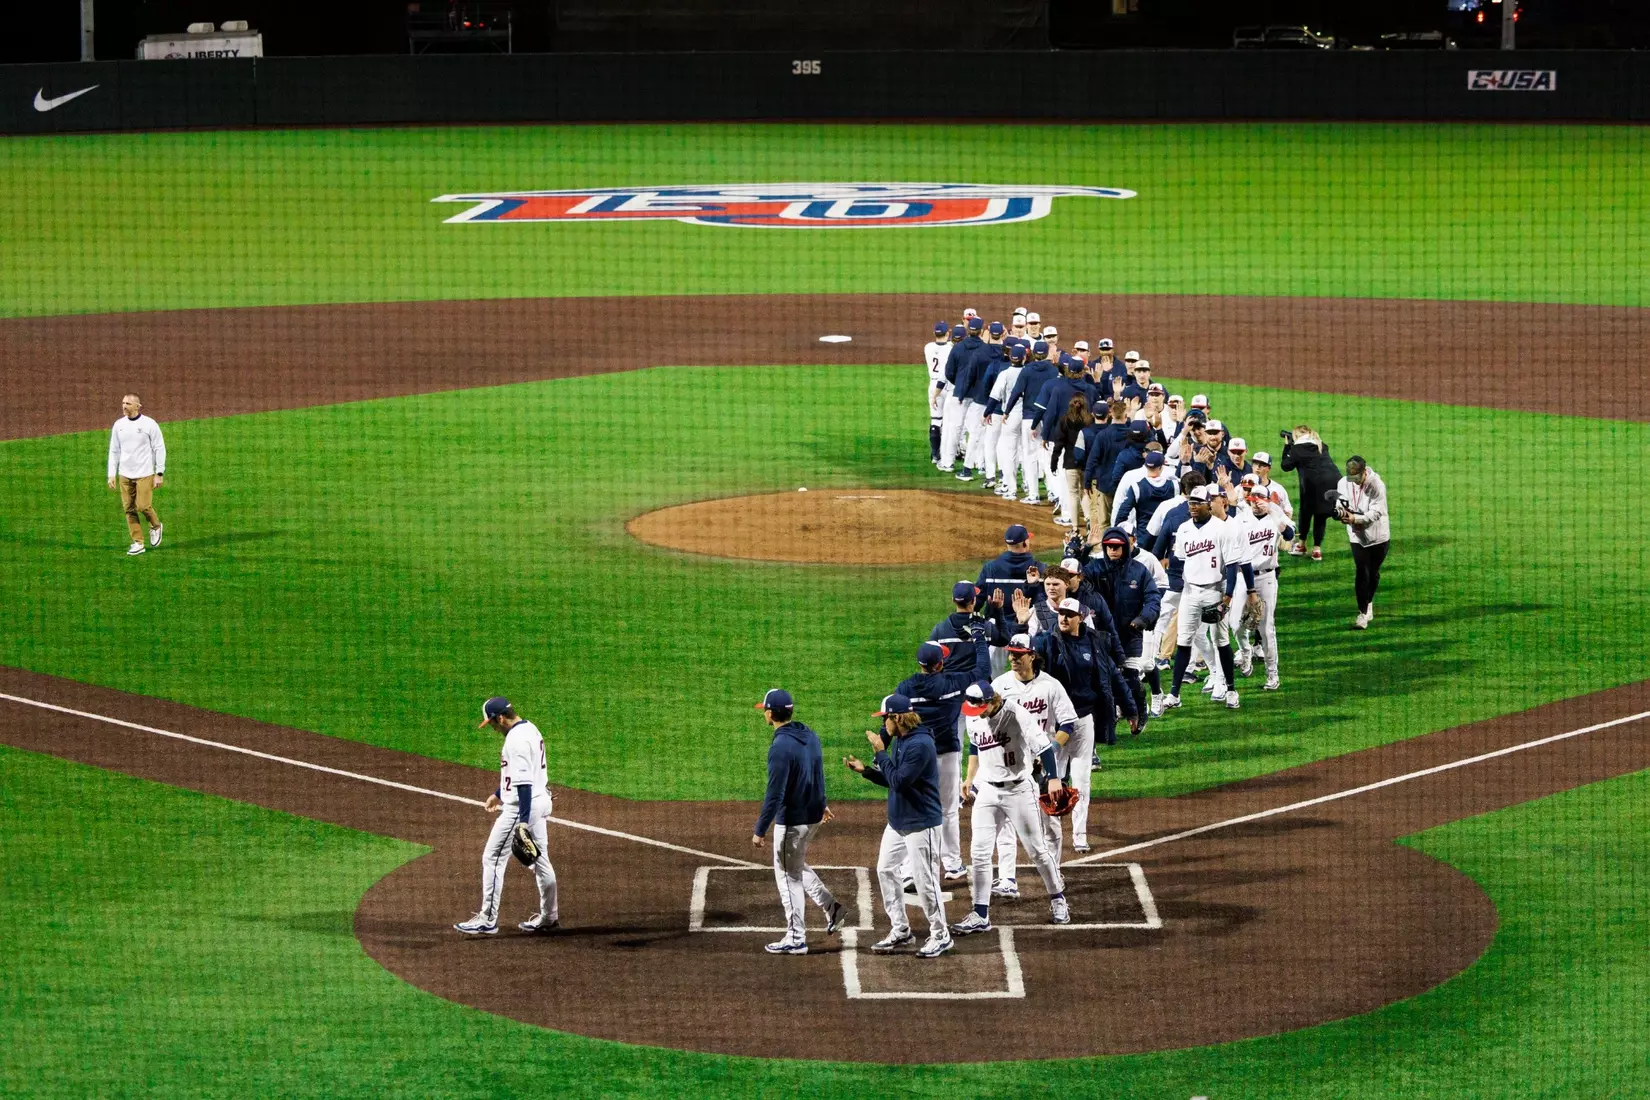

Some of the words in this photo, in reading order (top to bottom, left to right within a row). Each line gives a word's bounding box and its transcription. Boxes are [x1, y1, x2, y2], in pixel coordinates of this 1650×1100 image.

[187, 49, 239, 59] LIBERTY
[791, 60, 822, 75] 395
[932, 357, 939, 373] 2
[1248, 528, 1275, 545] berty
[1184, 538, 1216, 557] Liberty
[1211, 556, 1217, 568] 5
[1018, 697, 1048, 714] erty
[973, 731, 1012, 751] Liberty
[1003, 751, 1016, 767] 18
